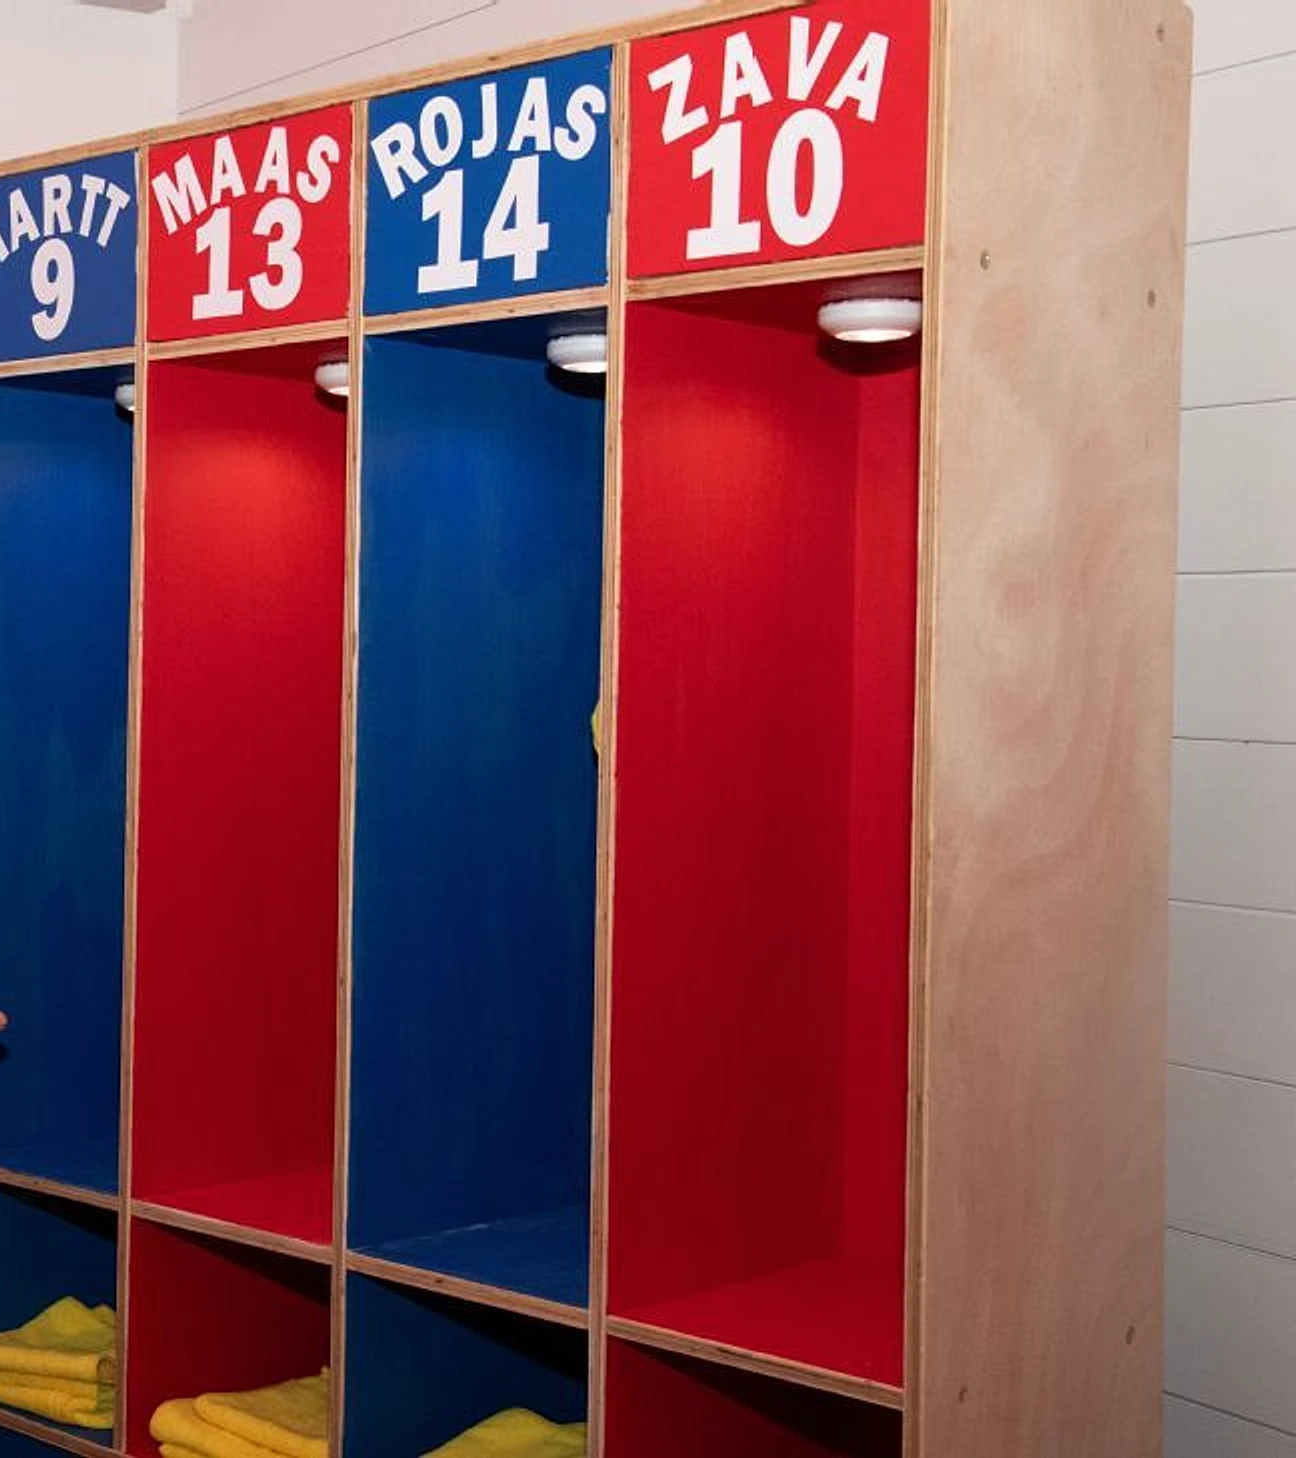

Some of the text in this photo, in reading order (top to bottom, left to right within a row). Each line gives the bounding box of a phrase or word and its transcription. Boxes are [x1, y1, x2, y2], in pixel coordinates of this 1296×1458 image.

[370, 77, 606, 199] ROJAS
[648, 16, 889, 144] ZAVA
[151, 126, 340, 234] MAAS
[418, 155, 549, 294] 14
[686, 108, 843, 260] 10
[31, 238, 75, 341] 9
[192, 197, 303, 320] 13
